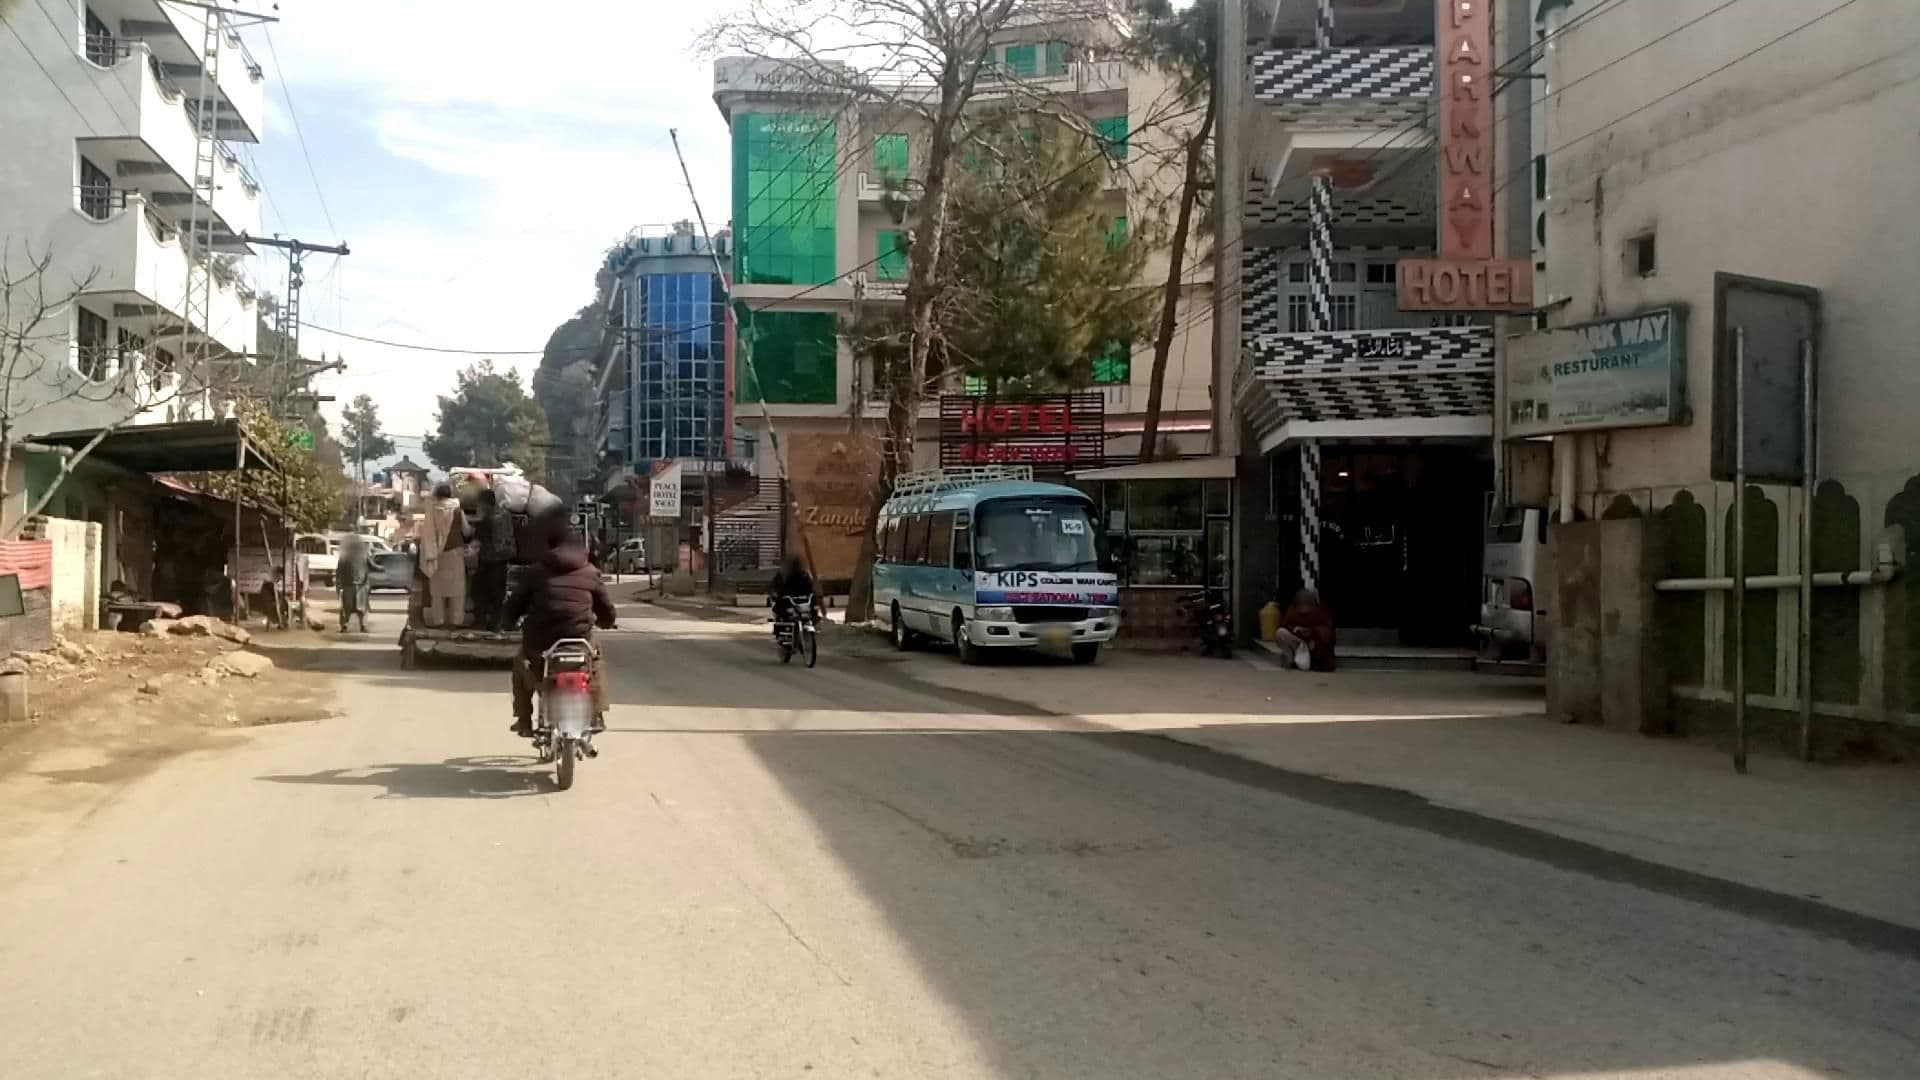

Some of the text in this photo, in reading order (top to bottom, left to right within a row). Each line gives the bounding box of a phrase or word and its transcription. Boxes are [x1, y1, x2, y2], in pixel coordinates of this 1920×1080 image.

[1446, 0, 1482, 249] PARKWAY
[1402, 264, 1529, 305] HOTEL
[1619, 314, 1667, 345] WAY
[1554, 354, 1640, 377] RESTURANT
[961, 405, 1078, 433] HOTEL
[653, 491, 678, 499] HOTEL
[655, 500, 676, 508] SWAT
[997, 572, 1038, 587] KIPS
